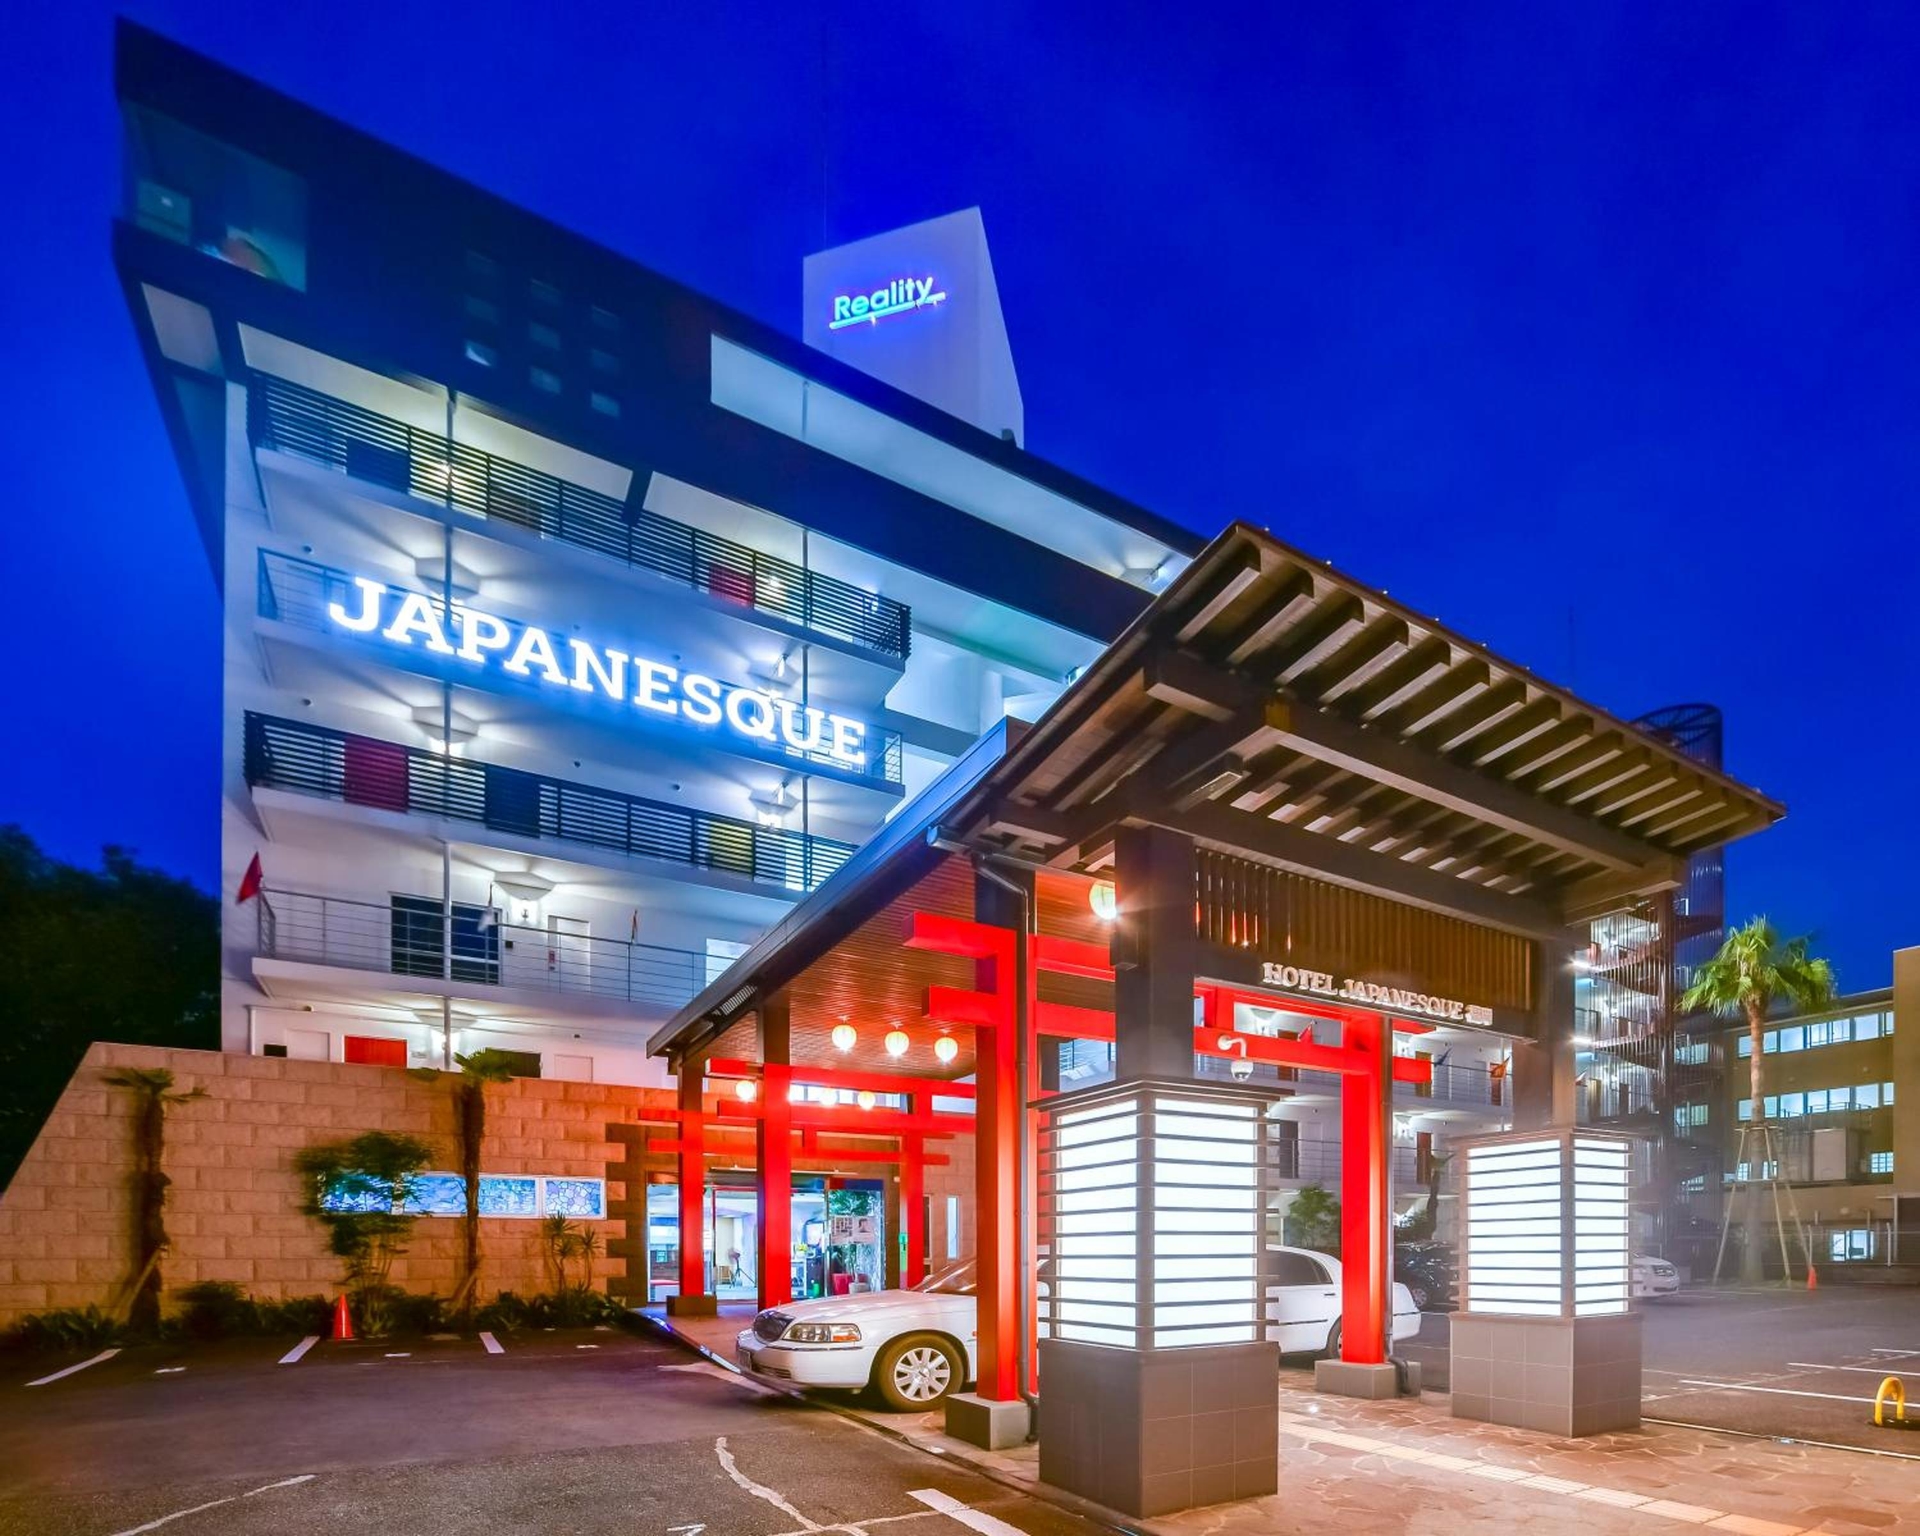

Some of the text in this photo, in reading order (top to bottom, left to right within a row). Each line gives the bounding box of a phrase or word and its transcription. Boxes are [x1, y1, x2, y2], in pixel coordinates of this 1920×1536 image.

[832, 276, 938, 324] Reality
[328, 576, 868, 767] JAPANESQUE
[1262, 961, 1338, 996] HOTEL
[1339, 978, 1464, 1021] JAPANESQUE
